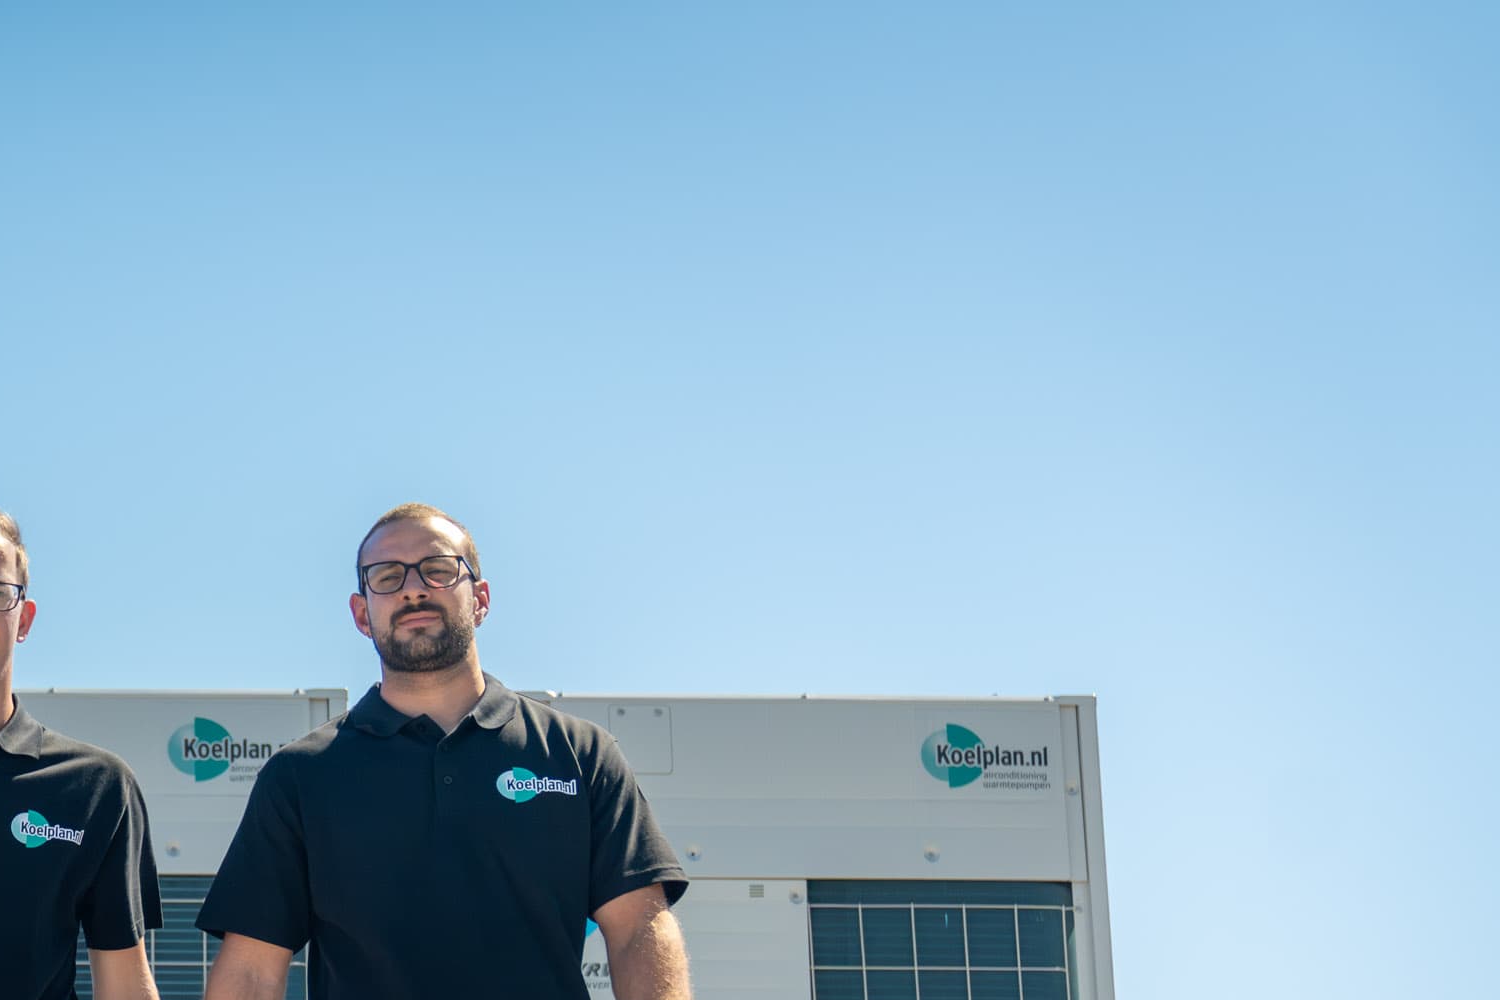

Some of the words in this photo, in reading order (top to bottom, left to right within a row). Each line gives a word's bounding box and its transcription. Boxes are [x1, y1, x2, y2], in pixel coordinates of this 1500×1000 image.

[936, 744, 1049, 770] Koelplan.nl
[983, 771, 1047, 781] airconditioning
[506, 777, 576, 795] Koelplan.nl
[983, 782, 1051, 790] warmtepompen
